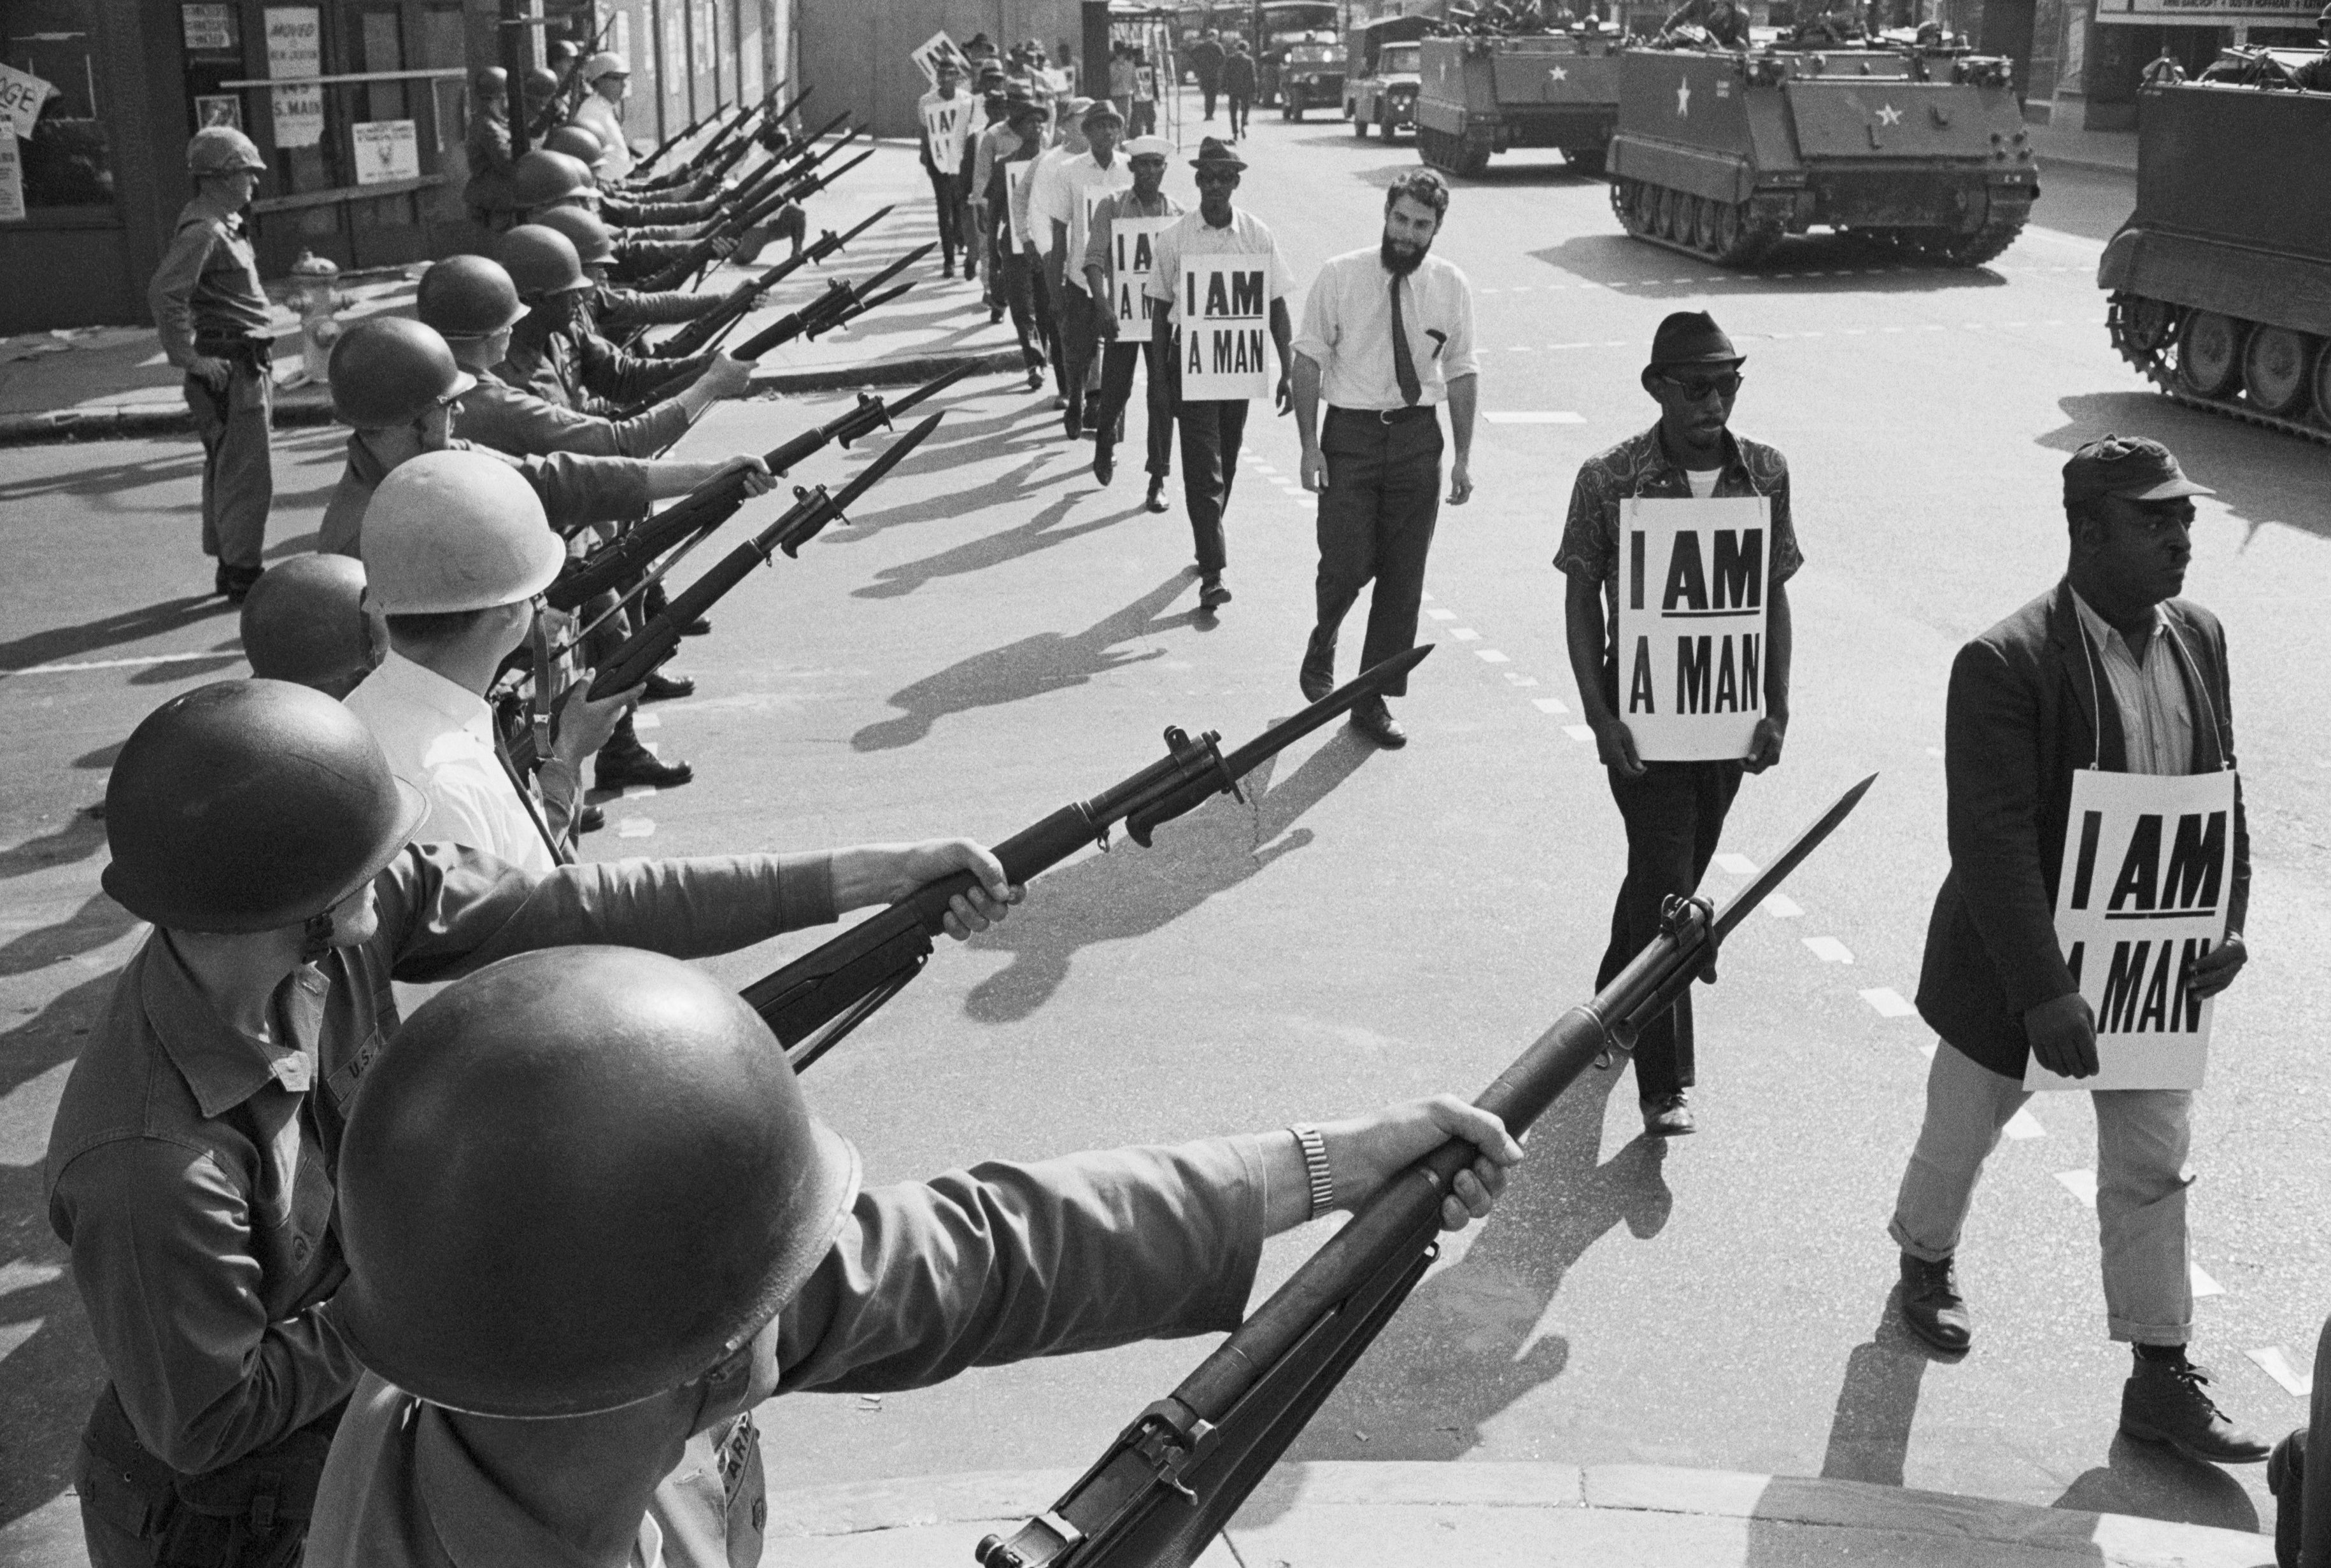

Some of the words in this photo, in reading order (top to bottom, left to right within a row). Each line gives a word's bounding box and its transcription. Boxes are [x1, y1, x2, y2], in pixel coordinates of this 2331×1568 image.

[1117, 234, 1125, 271] I
[1120, 283, 1132, 320] A
[1187, 271, 1195, 316] I
[1205, 271, 1265, 316] AM
[1188, 330, 1202, 374] A
[1213, 328, 1264, 374] MAN
[1630, 530, 1645, 610] I
[1661, 528, 1763, 611] AM
[1629, 635, 1655, 714] A
[1676, 633, 1761, 715] MAN
[2071, 810, 2102, 910] I
[2106, 810, 2227, 911] AM
[2097, 938, 2211, 1035] MAN
[348, 1049, 374, 1079] U.S.
